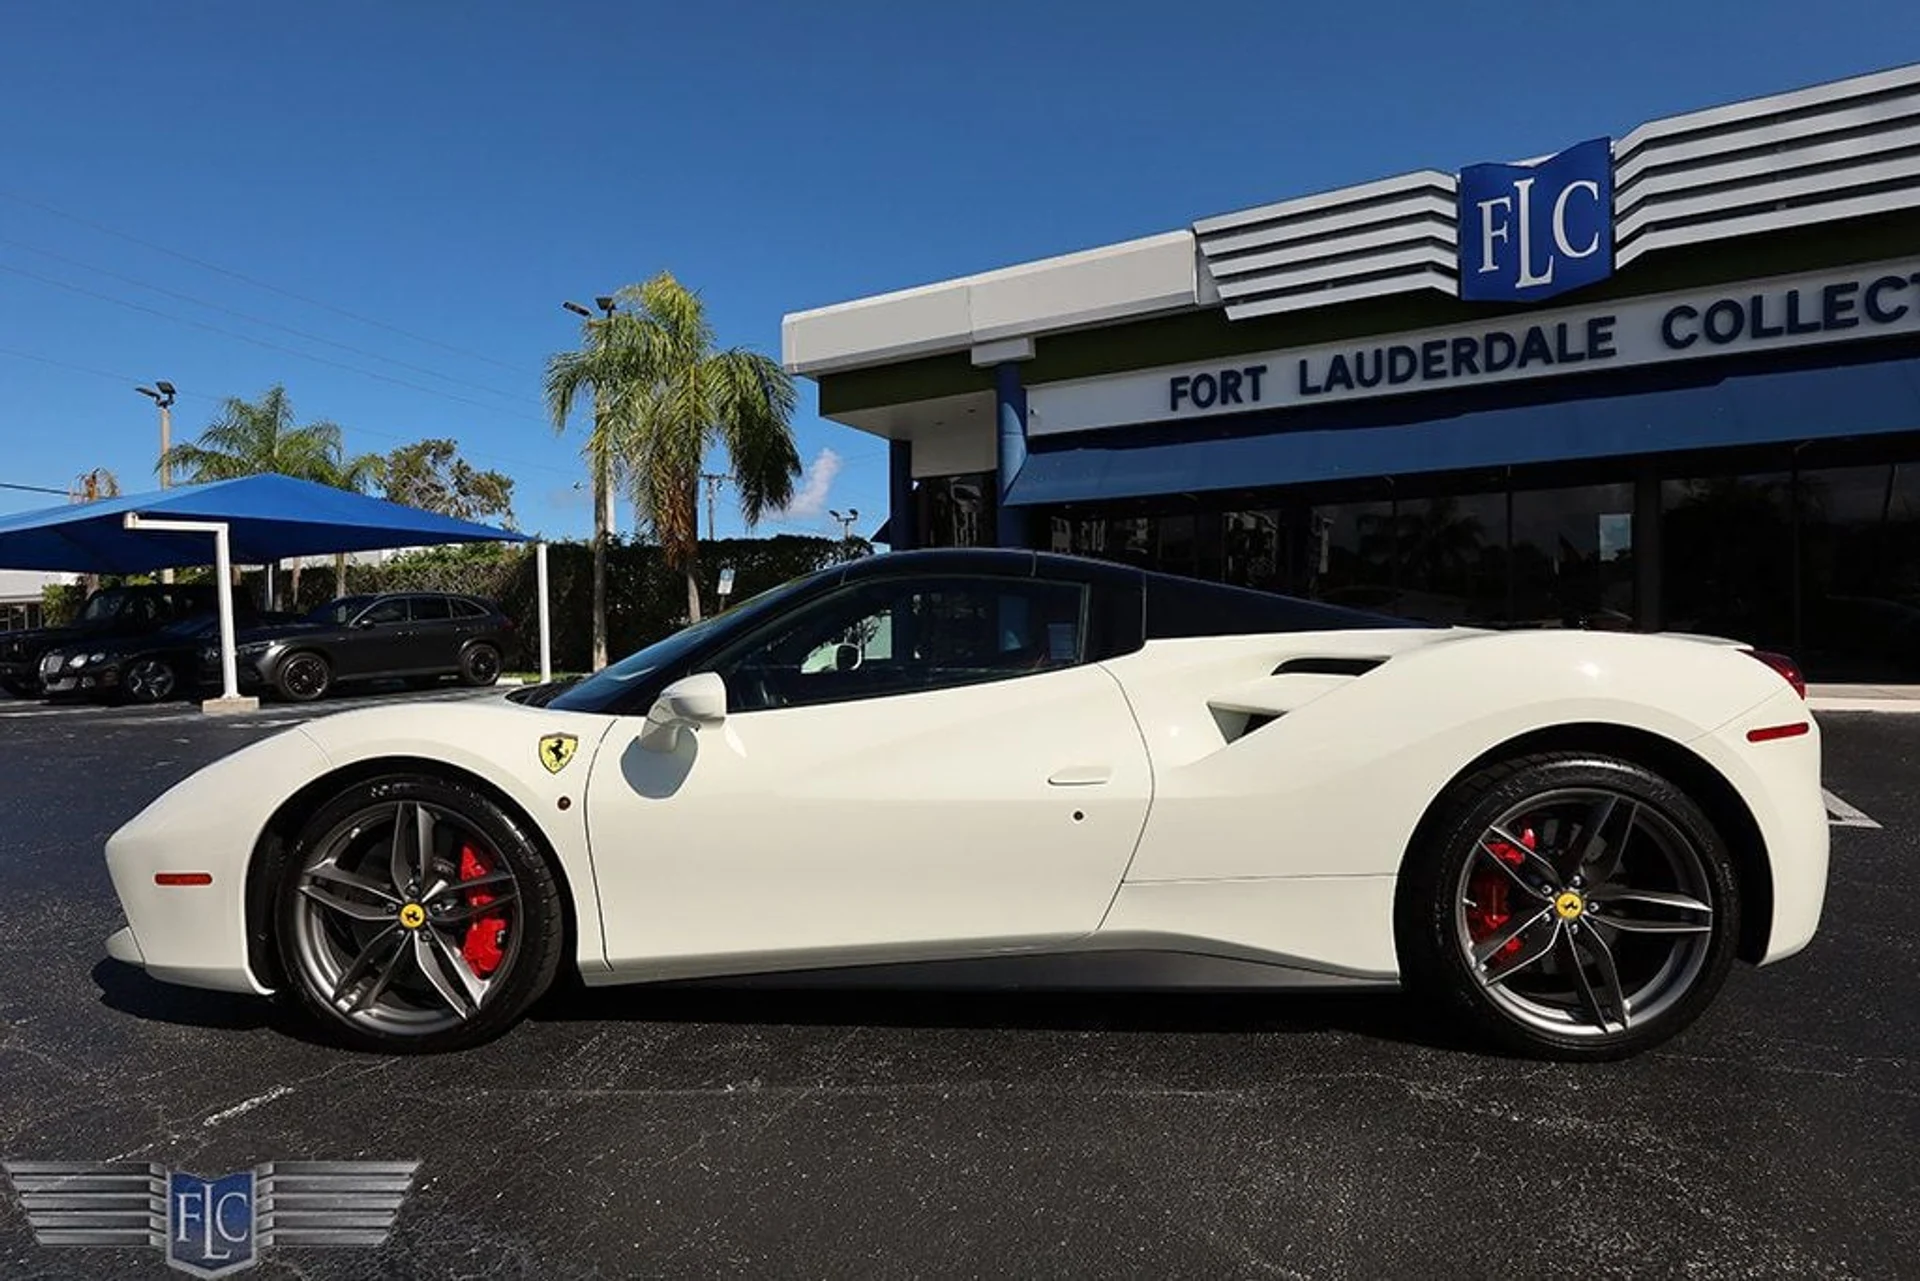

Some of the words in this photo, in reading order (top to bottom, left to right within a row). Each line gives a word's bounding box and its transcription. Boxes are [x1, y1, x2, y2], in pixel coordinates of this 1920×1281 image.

[1477, 177, 1599, 289] FLC
[1170, 365, 1267, 412] FORT
[1299, 315, 1617, 396] LAUDERDALE
